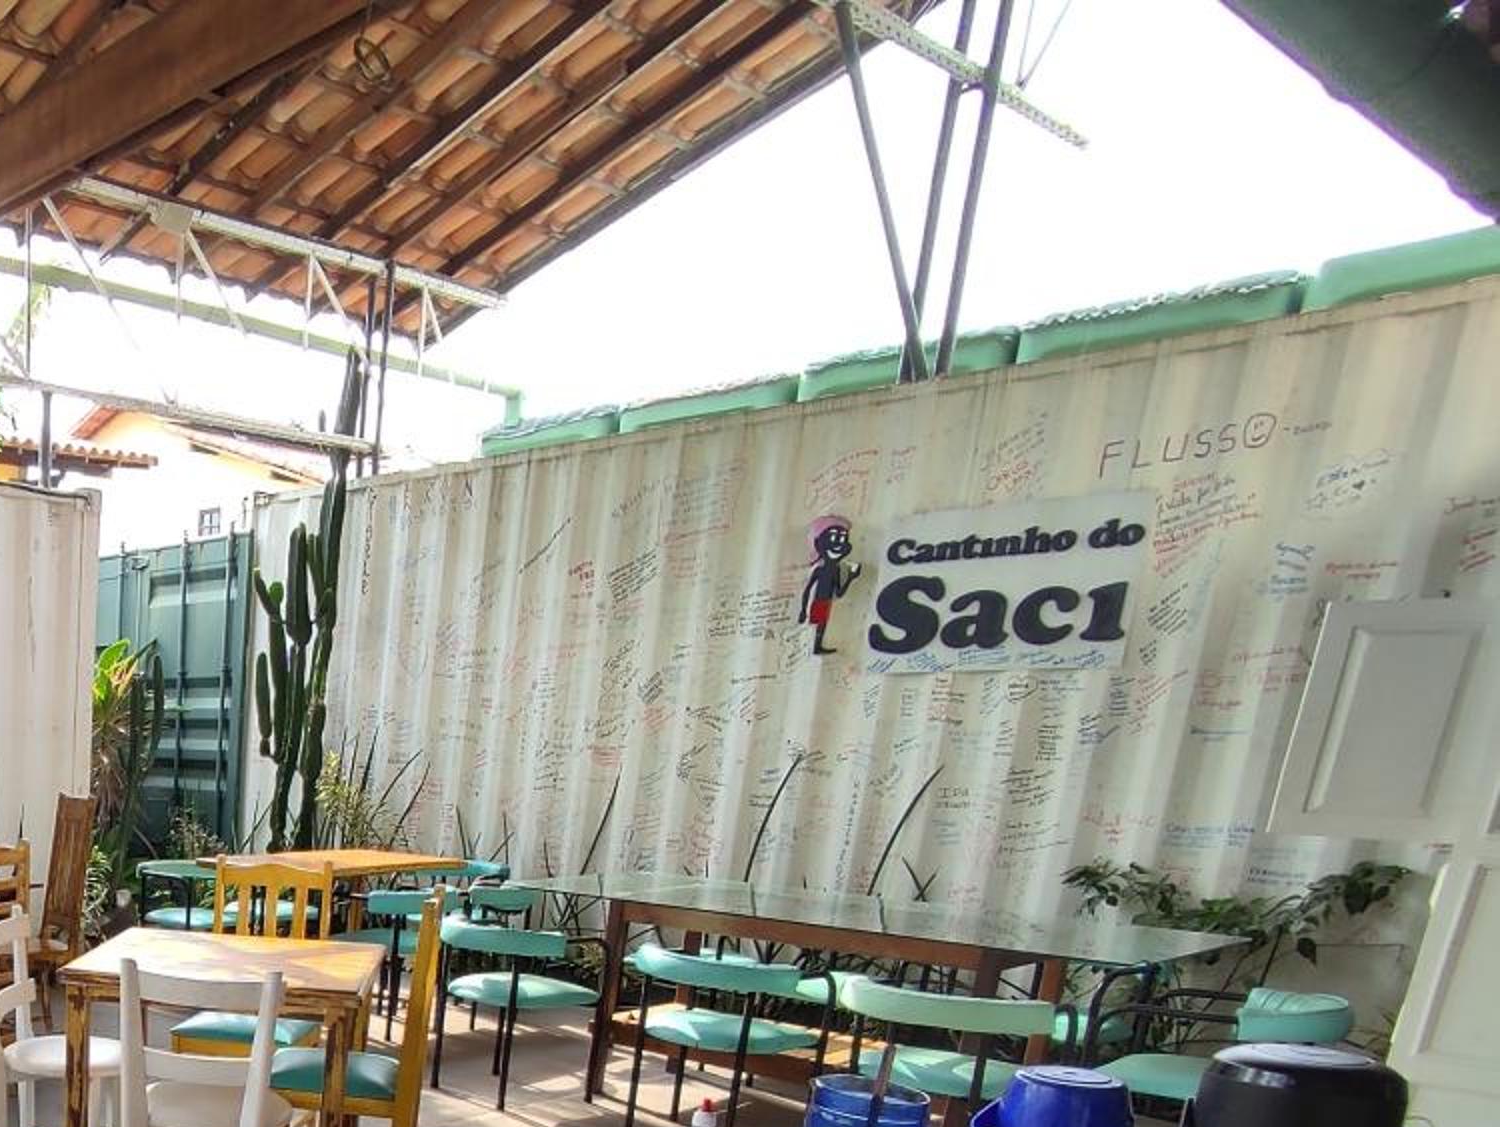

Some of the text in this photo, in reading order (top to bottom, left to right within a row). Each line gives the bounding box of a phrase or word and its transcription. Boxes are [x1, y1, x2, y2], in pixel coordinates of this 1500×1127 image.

[886, 517, 1146, 566] Cantinho do
[867, 574, 1130, 655] Saci
